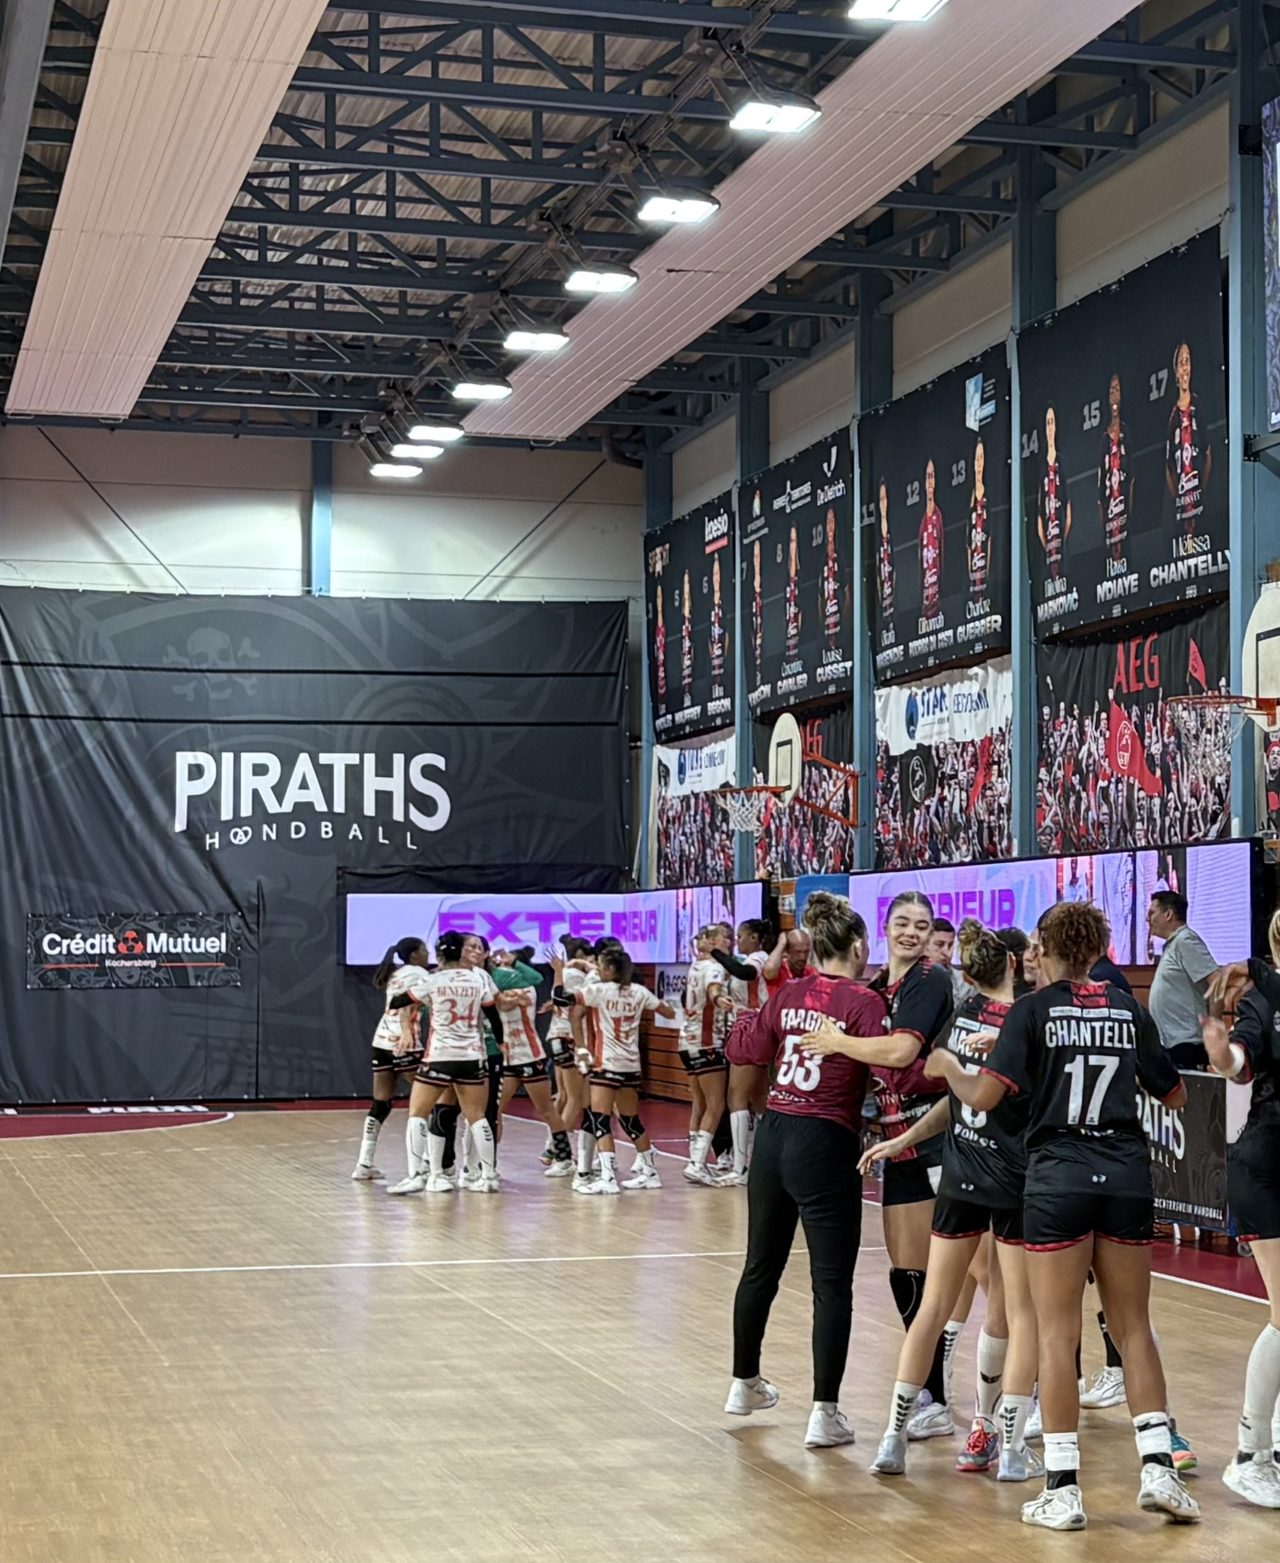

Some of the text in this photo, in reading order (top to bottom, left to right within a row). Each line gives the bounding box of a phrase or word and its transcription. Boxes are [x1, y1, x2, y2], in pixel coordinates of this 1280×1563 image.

[1150, 369, 1168, 401] 17
[1083, 400, 1100, 431] 15
[816, 661, 852, 682] CUSSET
[1114, 632, 1160, 694] AEG
[174, 751, 451, 832] PIRATHS
[205, 821, 418, 850] HANDBALL
[42, 933, 227, 955] Crédit Mutuel
[1045, 1019, 1136, 1050] CHANTELLY
[777, 1034, 824, 1091] 53
[1064, 1054, 1120, 1125] 17
